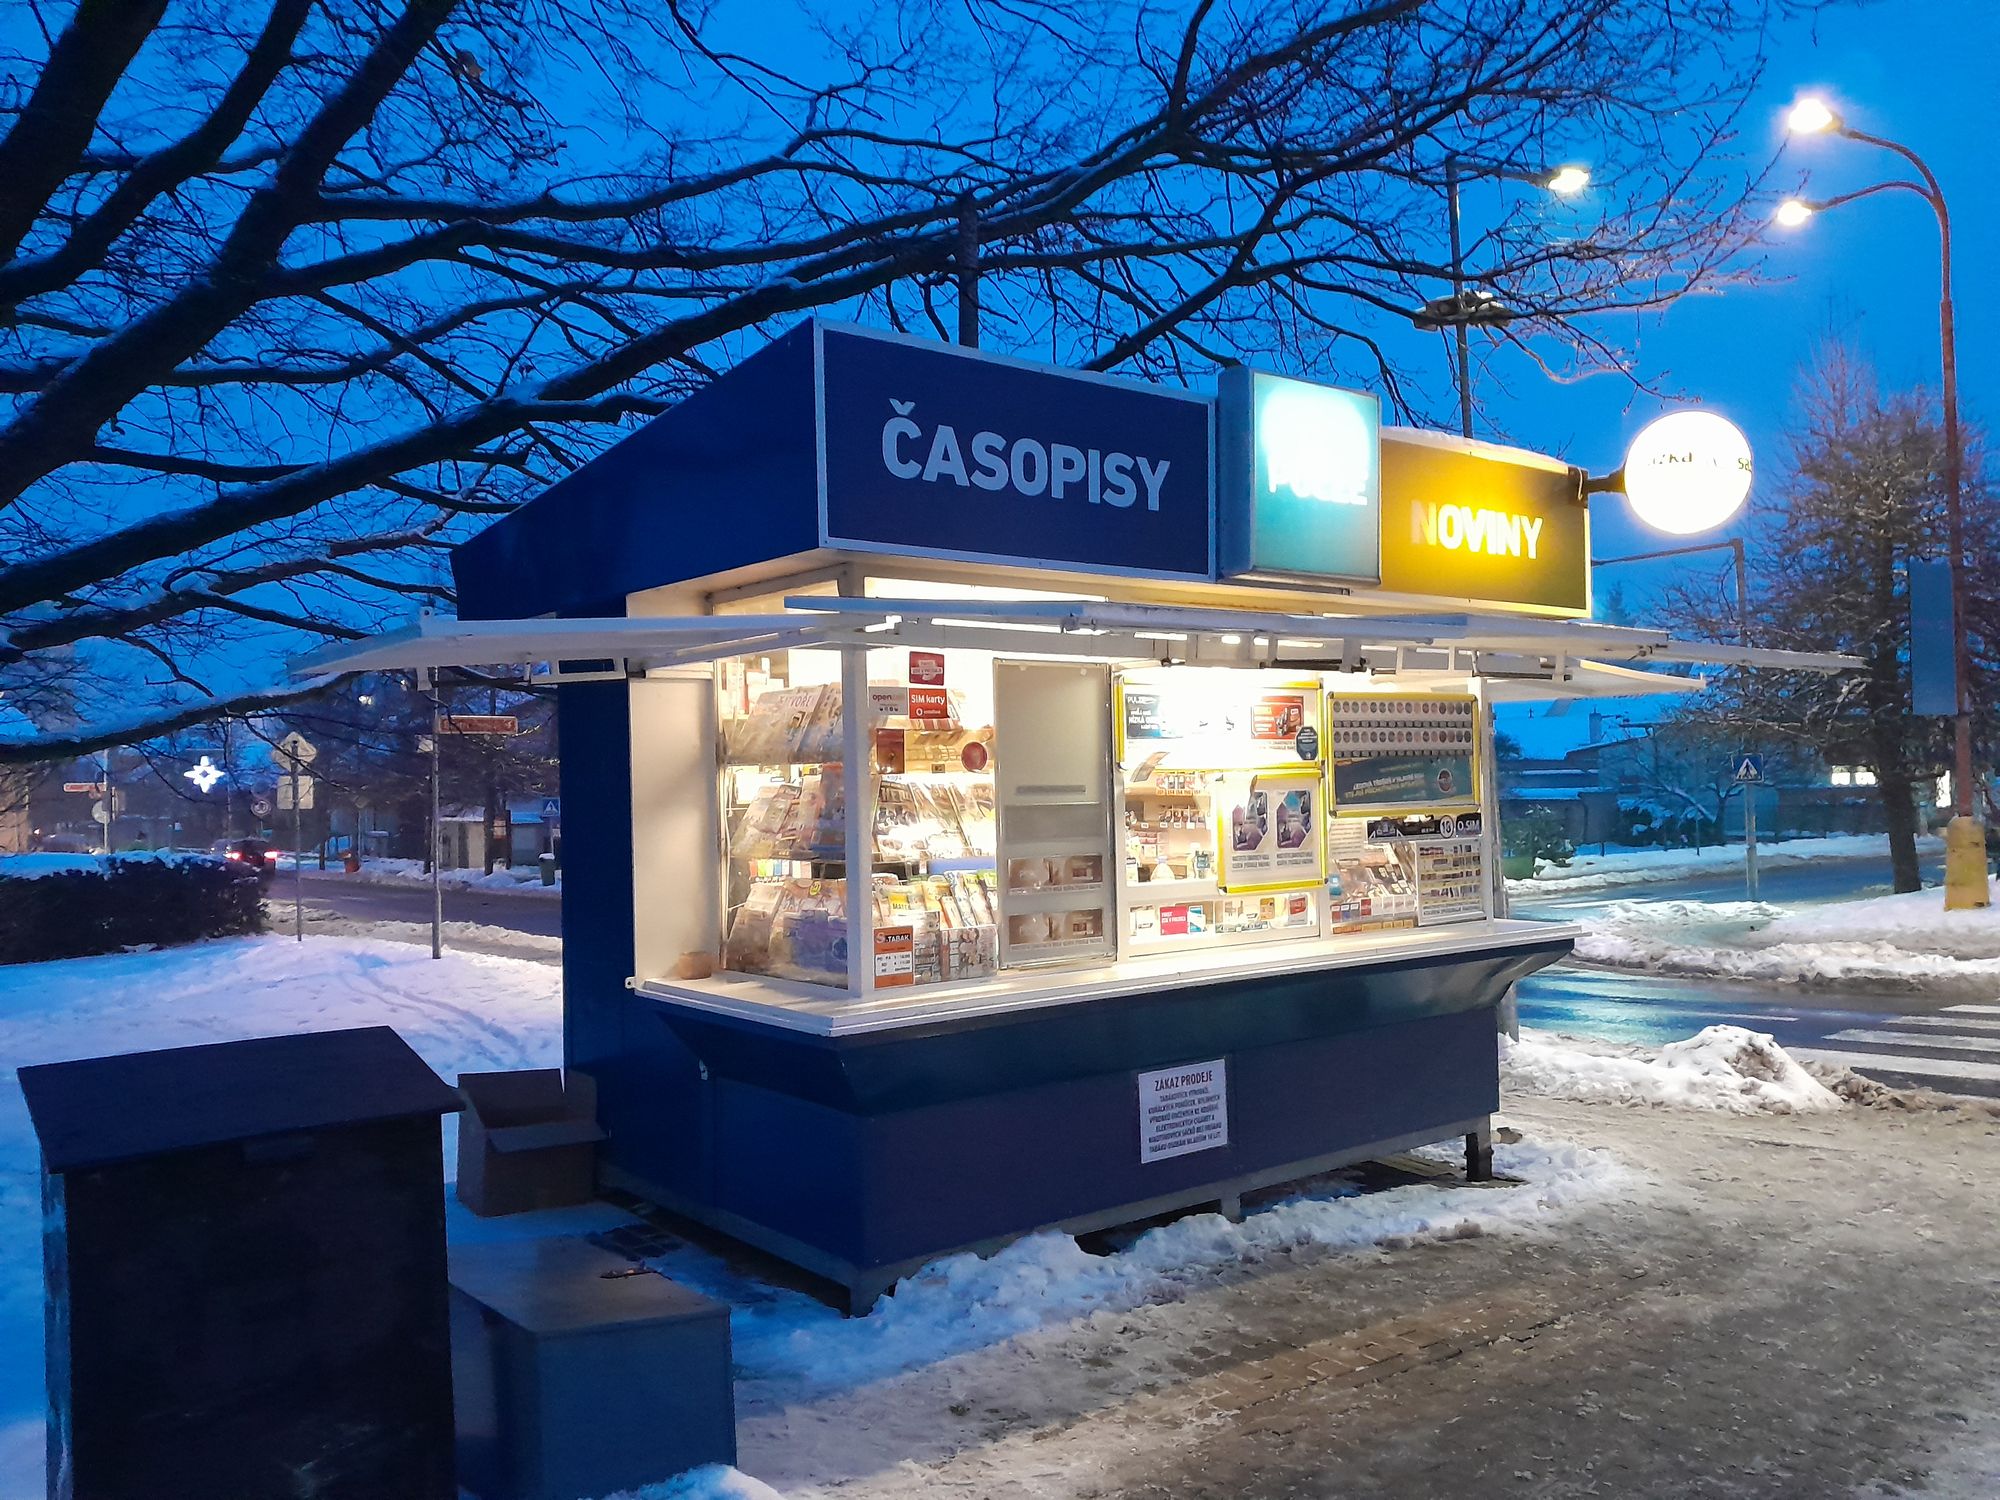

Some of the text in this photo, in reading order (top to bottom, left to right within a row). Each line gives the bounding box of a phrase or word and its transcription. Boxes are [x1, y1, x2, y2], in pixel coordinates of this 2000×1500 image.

[882, 398, 1170, 511] ČASOPISY
[1411, 499, 1543, 559] NOVINY
[872, 694, 892, 702] open
[911, 694, 945, 705] SIM karty
[1181, 1070, 1213, 1086] PRODEJE
